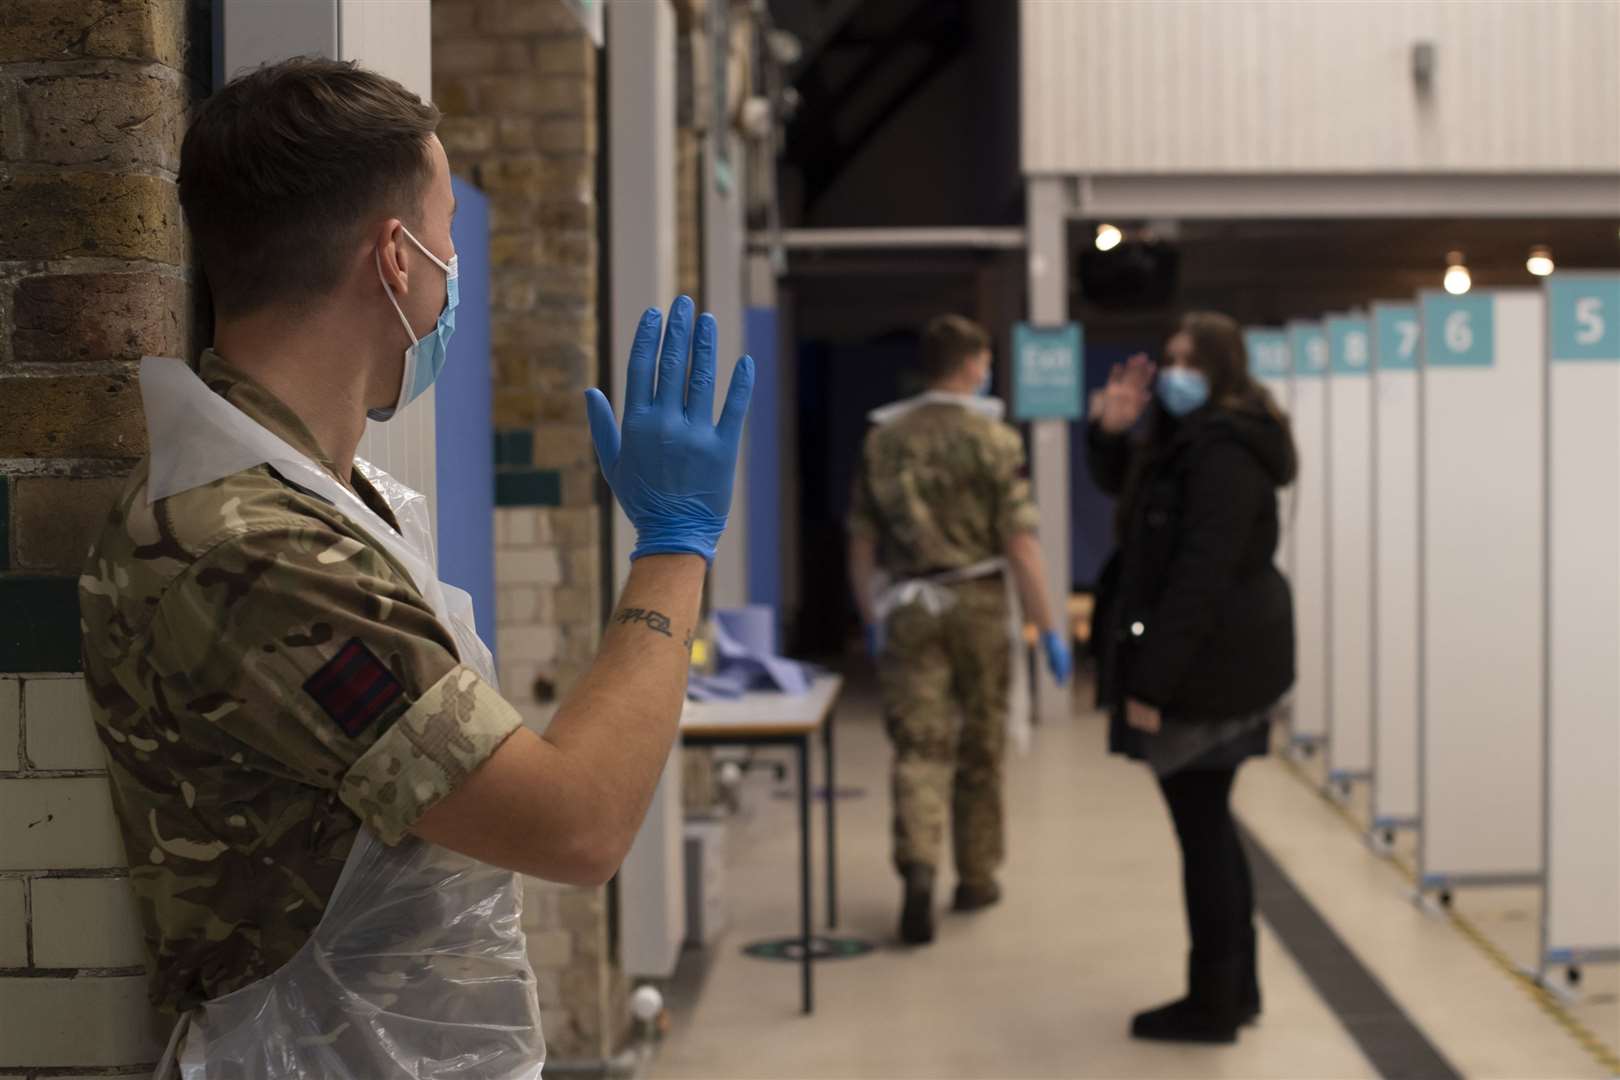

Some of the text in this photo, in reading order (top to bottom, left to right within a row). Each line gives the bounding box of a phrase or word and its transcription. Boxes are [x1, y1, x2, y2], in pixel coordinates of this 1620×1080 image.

[1393, 321, 1420, 358] 7
[1444, 310, 1473, 353] 6
[1575, 297, 1605, 346] 5
